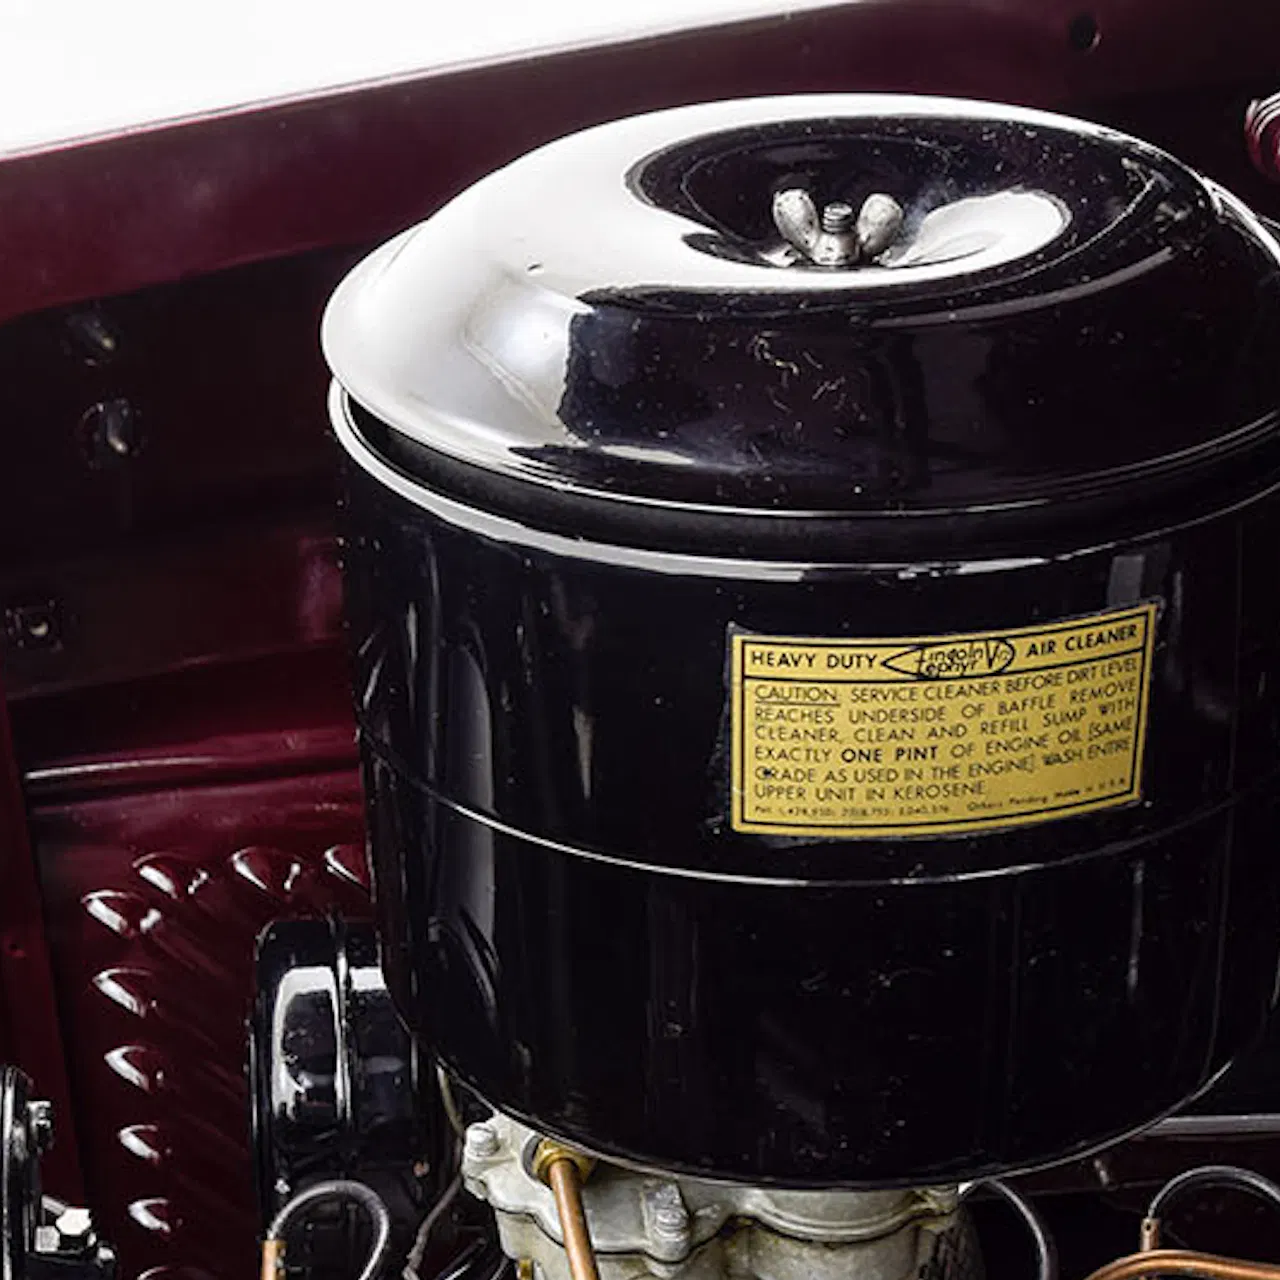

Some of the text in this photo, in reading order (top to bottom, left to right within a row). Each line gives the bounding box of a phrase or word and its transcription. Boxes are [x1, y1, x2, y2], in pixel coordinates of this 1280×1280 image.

[751, 651, 878, 669] HEAVY DUTY
[1026, 624, 1138, 658] AIR CLEANER
[754, 707, 835, 724] REACHES
[848, 706, 947, 724] UNDERSIDE
[961, 703, 985, 719] OF
[1071, 677, 1137, 704] REMOVE
[851, 687, 918, 703] SERVICE
[923, 680, 1001, 701] CLEANER
[1005, 672, 1063, 693] BEFORE
[1067, 665, 1097, 684] DIRT
[1101, 658, 1138, 678] LEVEL
[853, 727, 915, 743] CLEAN
[927, 722, 967, 739] AND
[980, 718, 1028, 736] REFILL
[1042, 707, 1087, 728] SUMP
[1099, 697, 1135, 716] WITH
[754, 745, 833, 762] EXACTLY
[841, 748, 883, 763] ONE
[895, 746, 939, 762] PINT
[950, 742, 977, 759] OF
[985, 733, 1049, 756] ENGINE
[1058, 728, 1083, 745] OIL
[754, 766, 816, 783] GRADE
[825, 767, 848, 783] AS
[853, 768, 899, 784] USED
[904, 768, 923, 781] IN
[932, 764, 962, 780] THE
[1042, 748, 1083, 767] WASH
[1087, 736, 1131, 760] ENTIRE
[754, 780, 985, 802] UPPER UNIT IN KEROSENE
